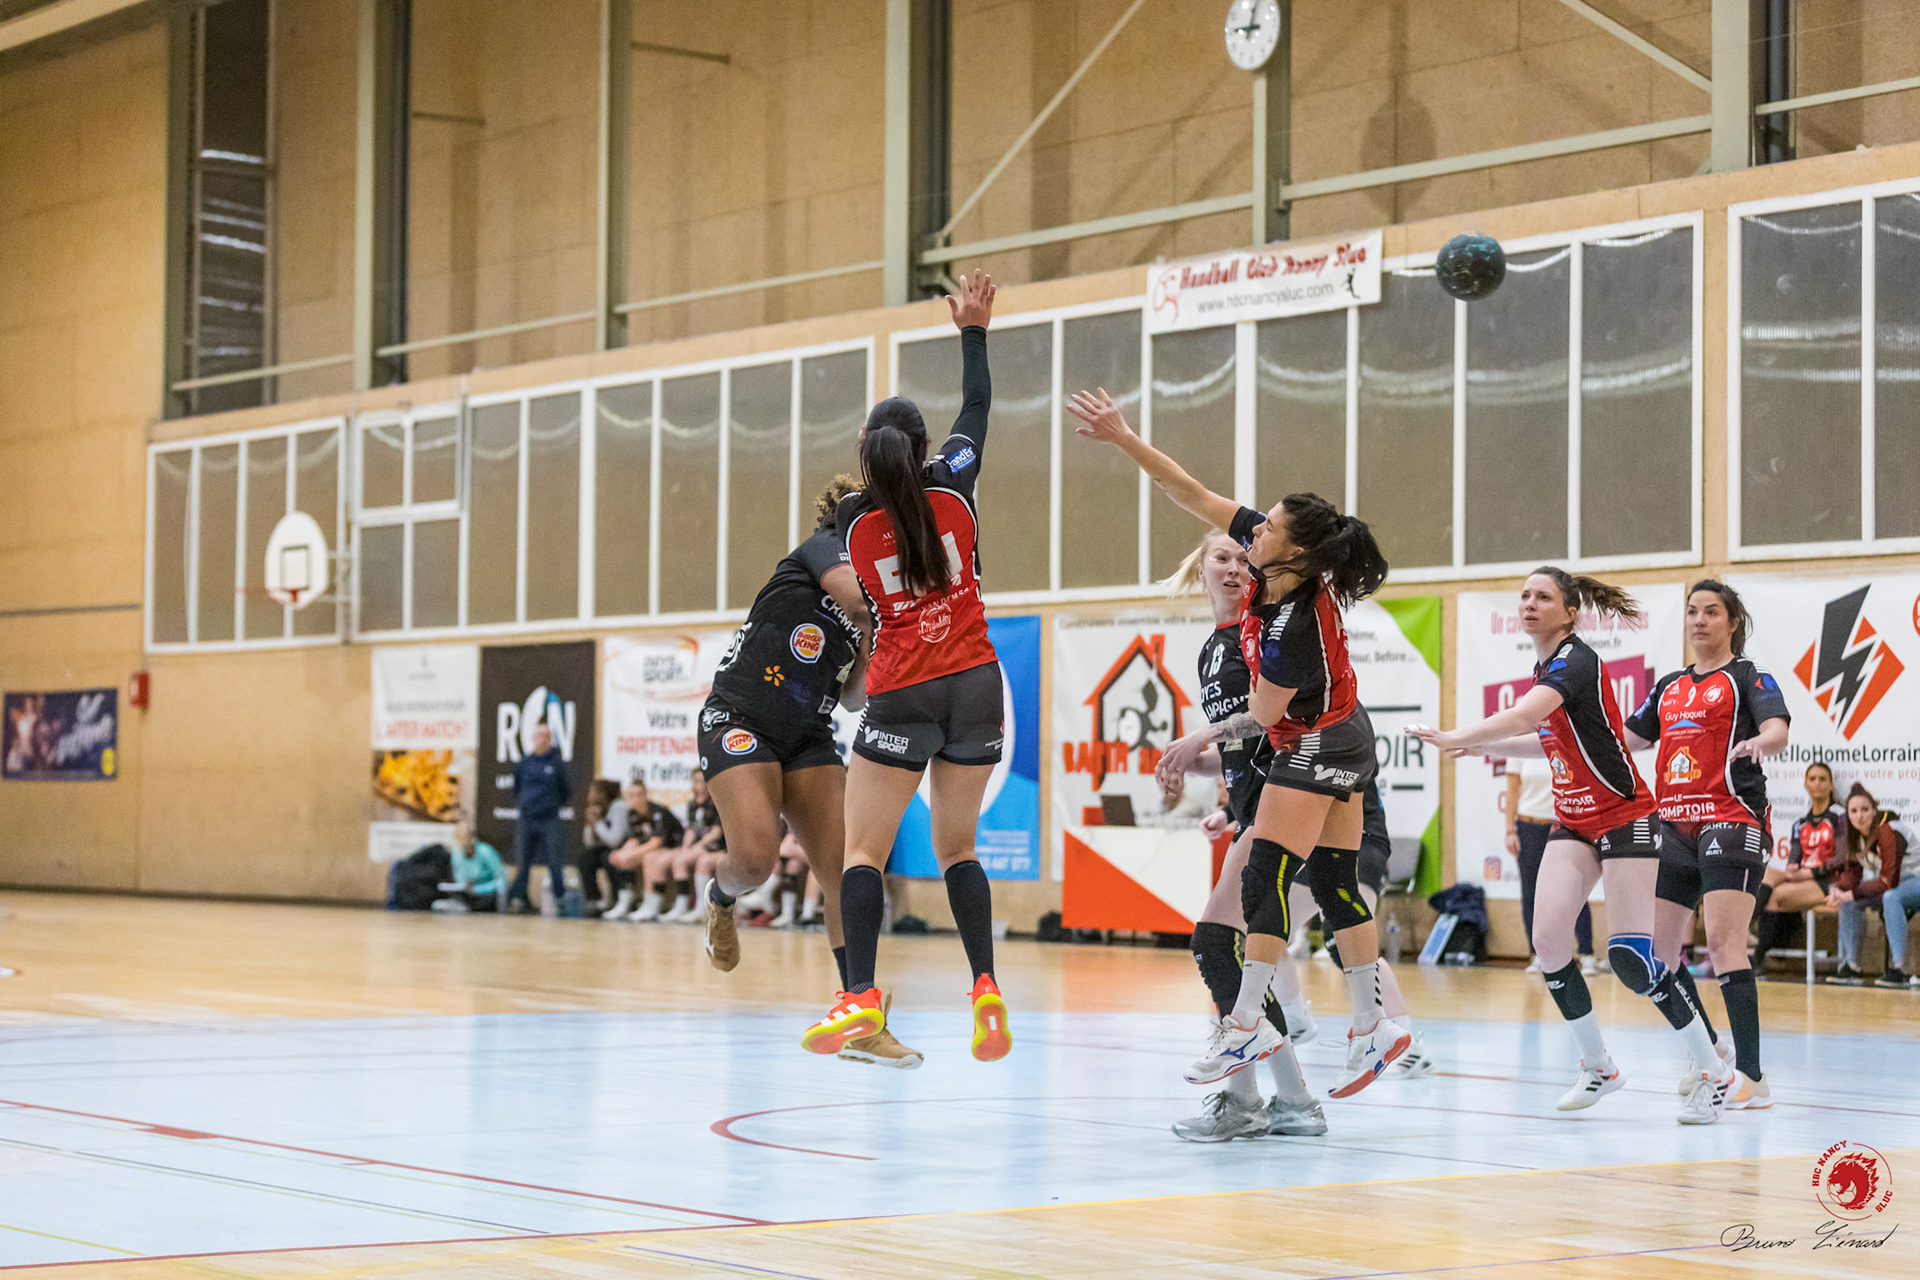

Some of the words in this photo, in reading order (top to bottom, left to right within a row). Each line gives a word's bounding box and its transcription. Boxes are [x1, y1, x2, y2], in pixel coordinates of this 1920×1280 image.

[1180, 260, 1239, 290] Handball
[794, 638, 821, 652] KING
[1208, 643, 1225, 678] 13
[1684, 685, 1697, 707] 9
[647, 710, 688, 728] Votre
[1665, 711, 1679, 722] Guy
[1680, 709, 1707, 720] Hoquet
[729, 737, 753, 751] KING
[878, 732, 909, 746] INTER
[877, 740, 907, 754] SPORT
[1335, 769, 1359, 780] INTER
[1834, 770, 1860, 780] pour
[1864, 770, 1893, 779] votre
[1674, 794, 1682, 802] LE
